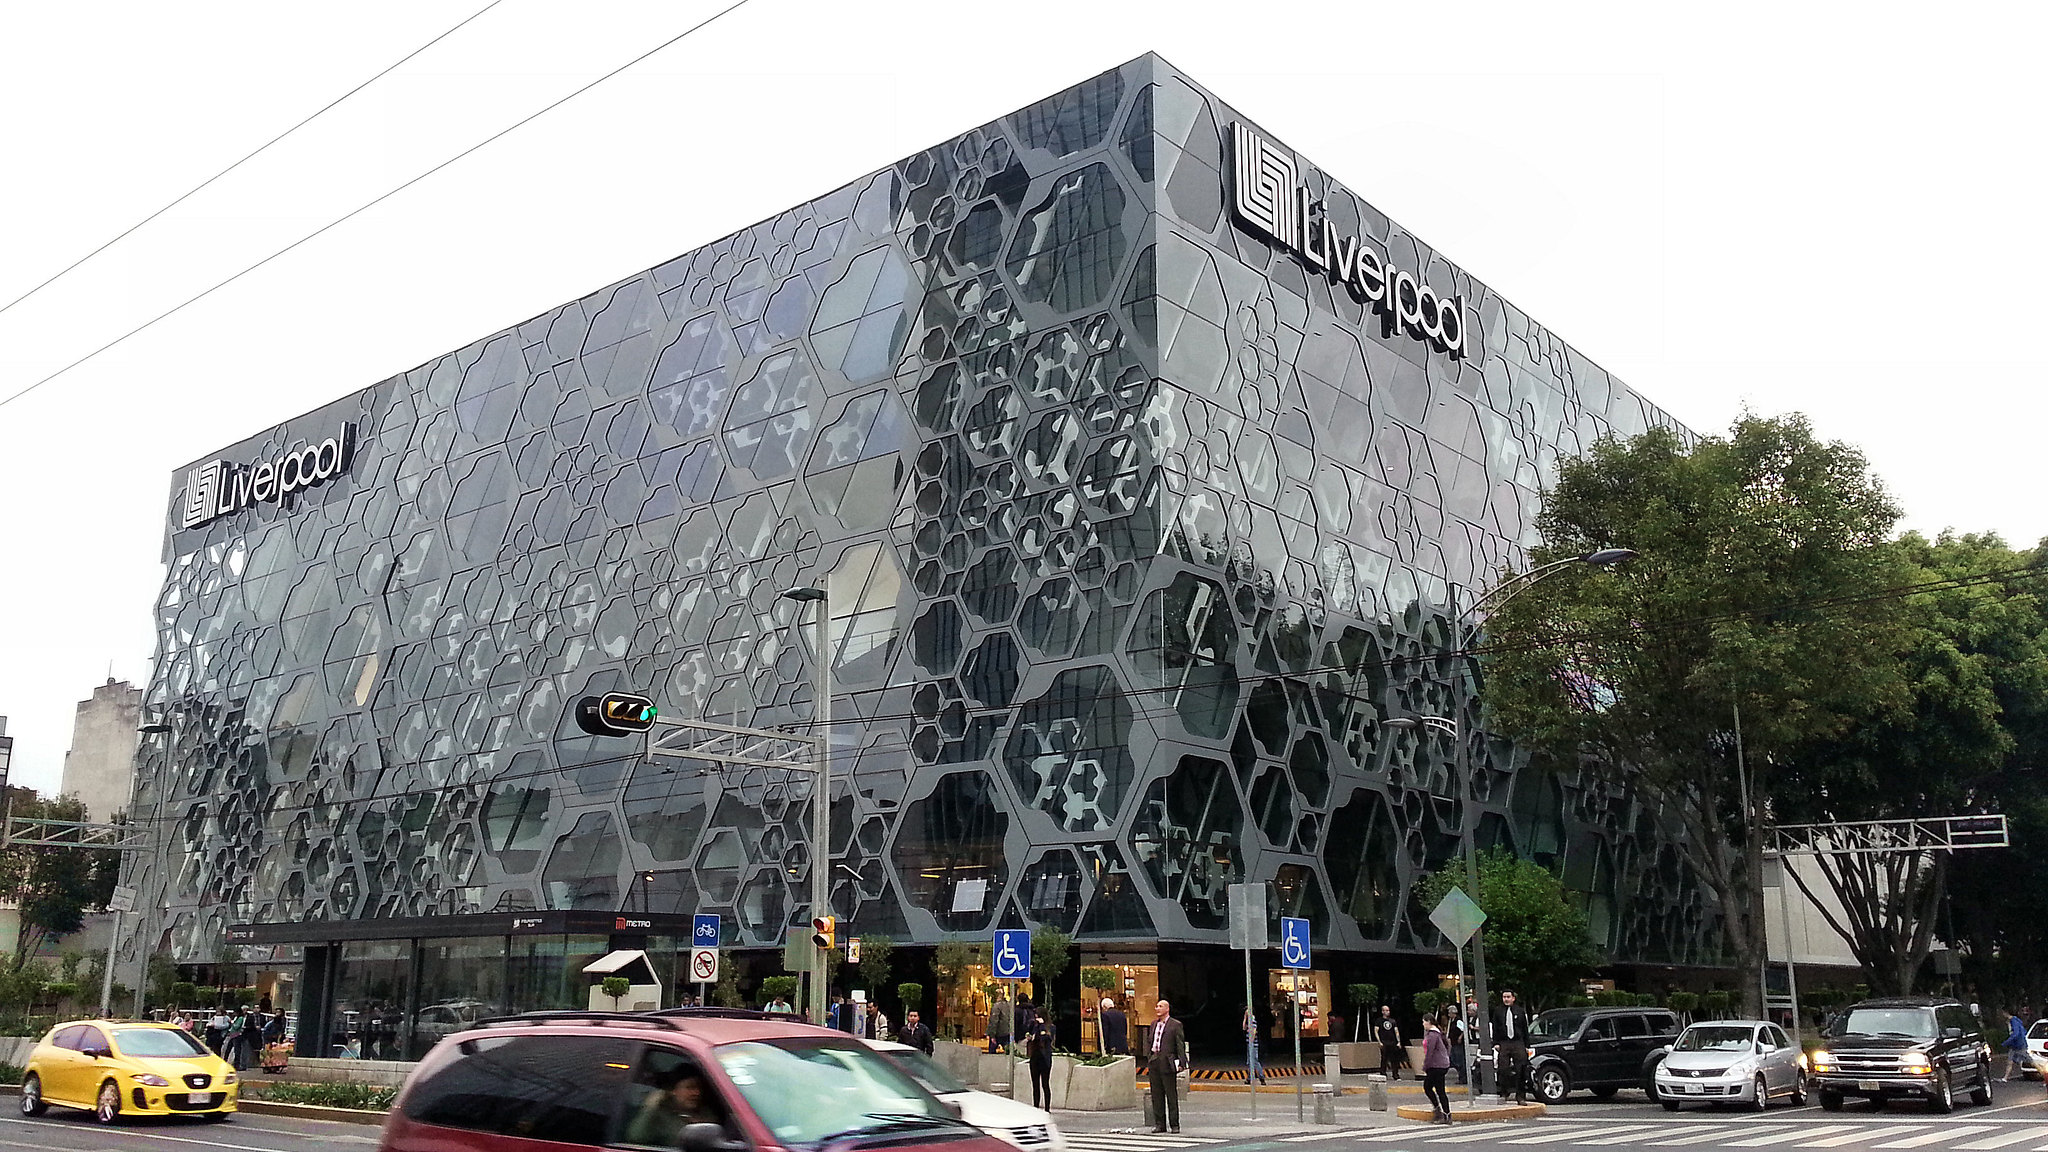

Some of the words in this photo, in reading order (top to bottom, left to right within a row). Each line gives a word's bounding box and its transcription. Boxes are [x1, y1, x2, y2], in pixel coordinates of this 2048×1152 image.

[1302, 186, 1468, 358] Liverpool
[218, 421, 350, 515] Liverpool
[626, 919, 651, 928] METRO
